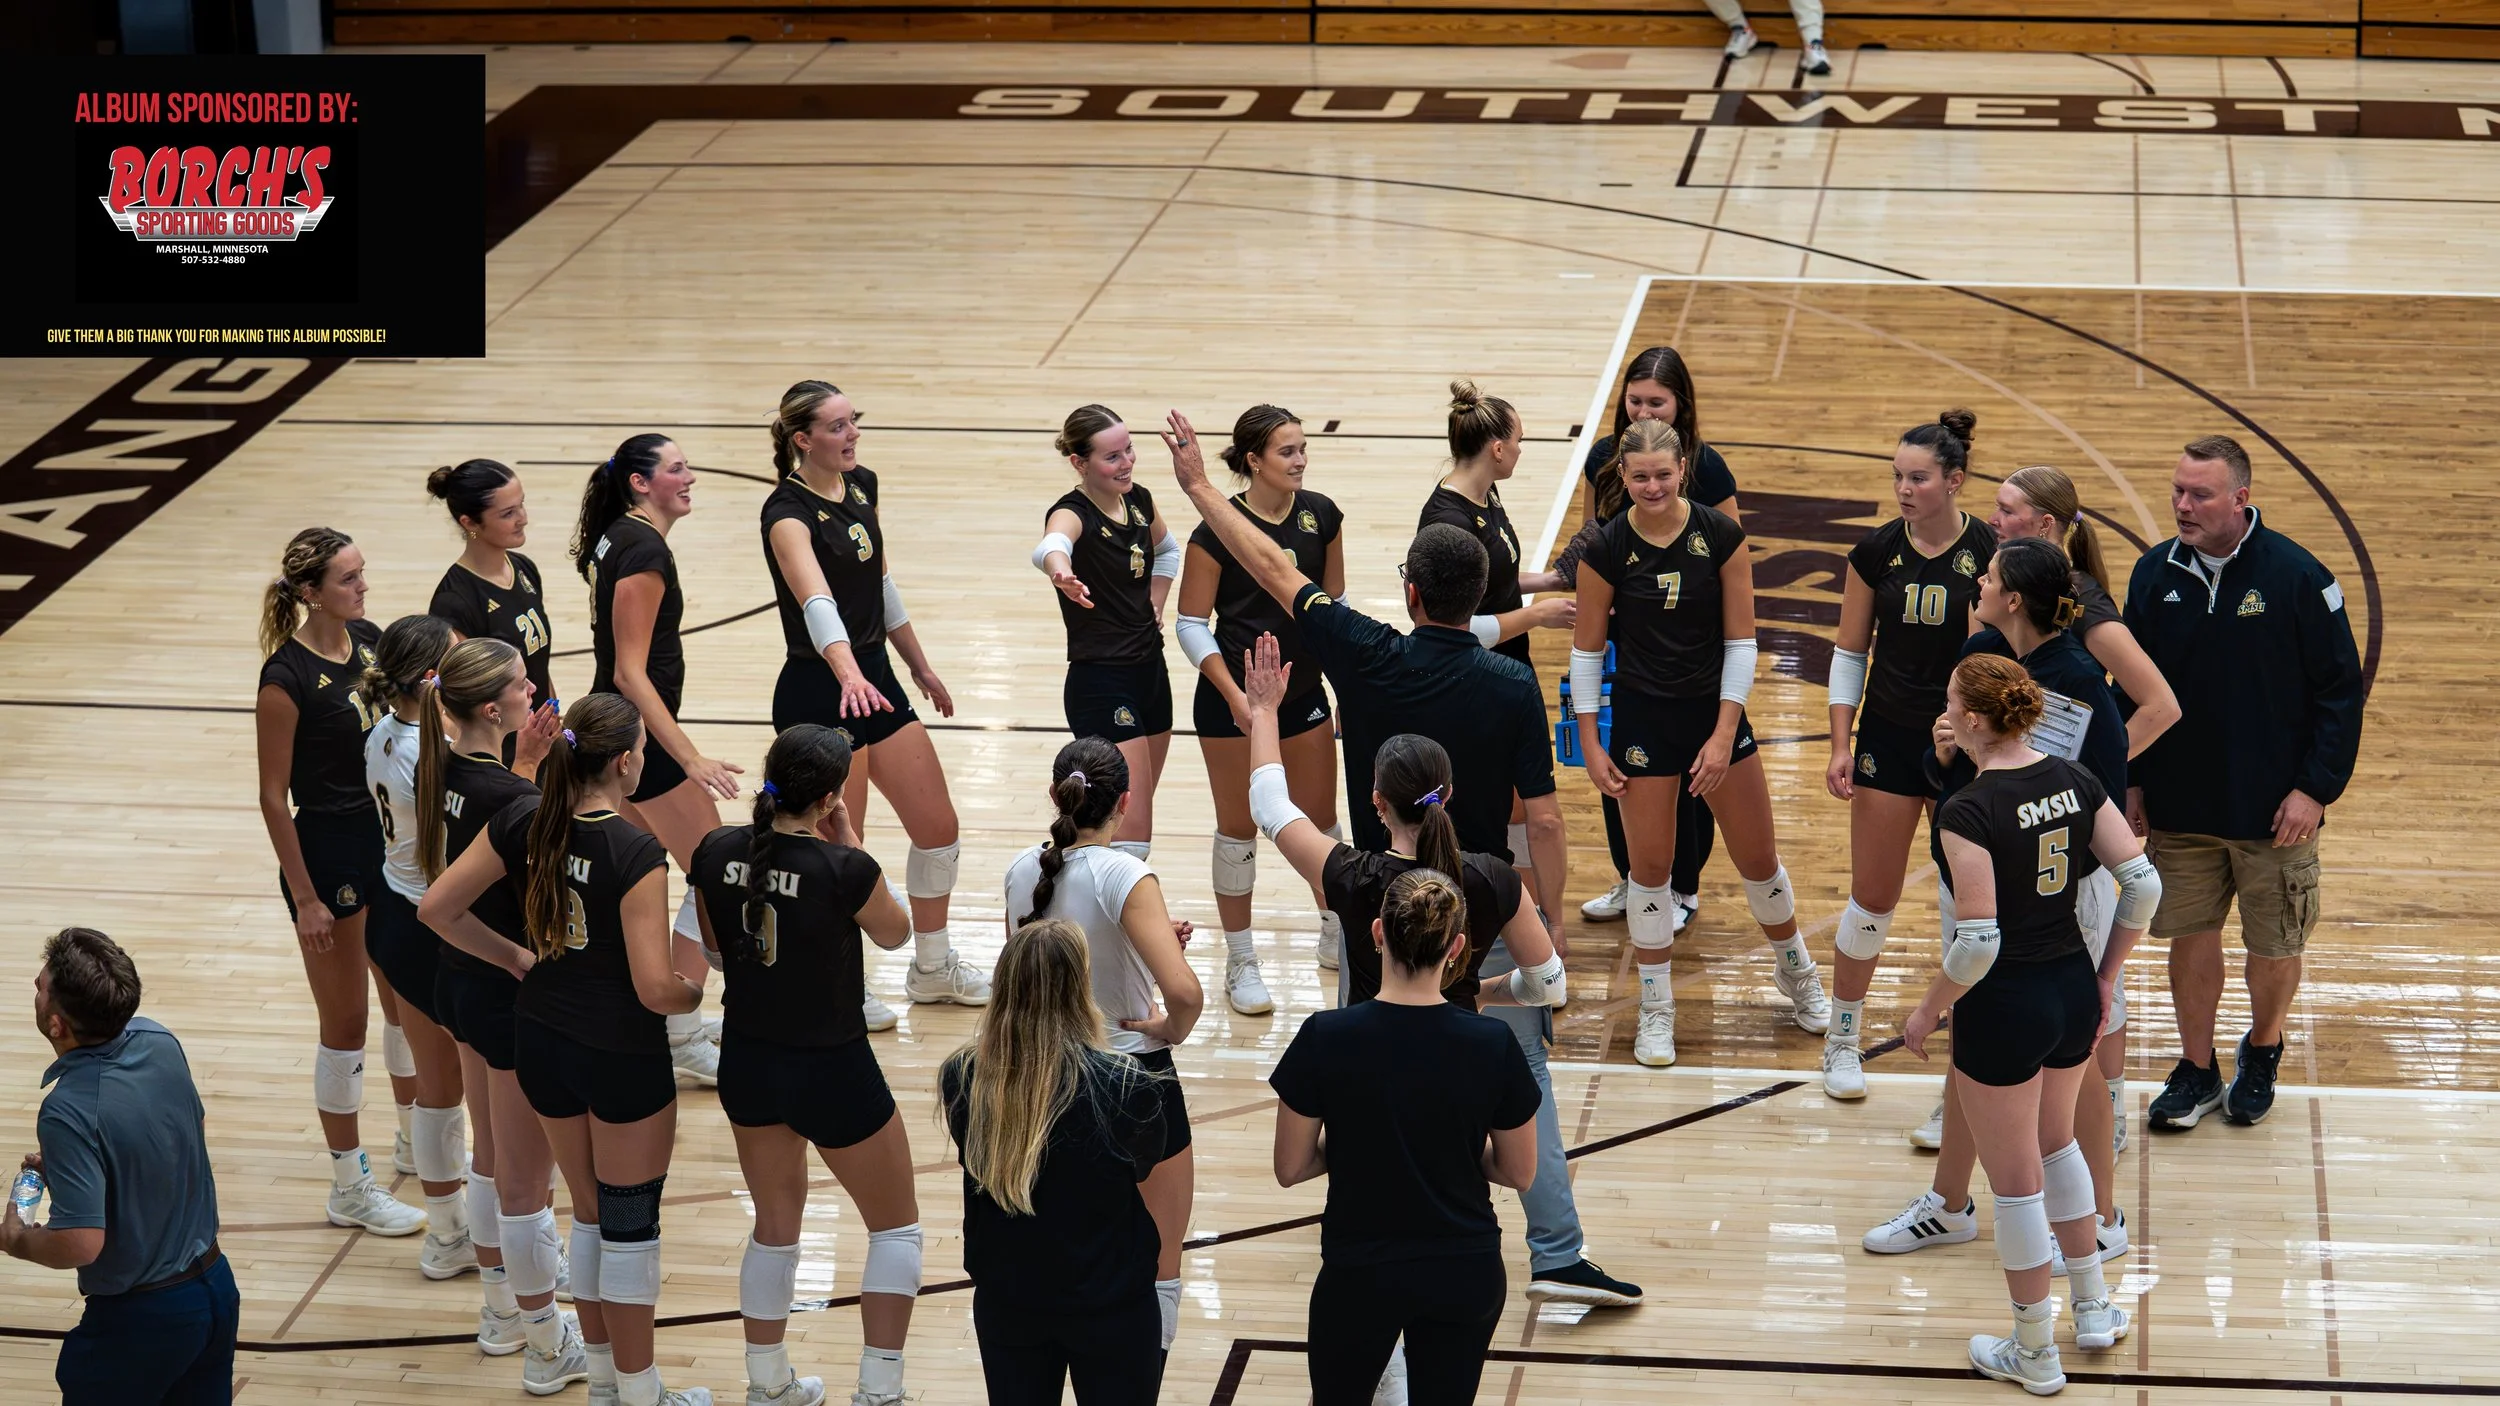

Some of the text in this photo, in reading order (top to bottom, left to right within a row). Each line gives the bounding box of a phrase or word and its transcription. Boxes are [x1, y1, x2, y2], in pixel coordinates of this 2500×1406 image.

[958, 88, 2360, 132] SOUTHWEST
[0, 357, 311, 591] ANG
[848, 522, 874, 562] 3
[1130, 543, 1145, 579] 4
[1656, 571, 1681, 609] 7
[1902, 583, 1947, 626] 10
[2237, 602, 2266, 616] SMSU
[515, 607, 548, 656] 21
[376, 781, 396, 843] 6
[444, 789, 466, 820] SU
[2017, 788, 2082, 830] SMSU
[2037, 826, 2069, 896] 5
